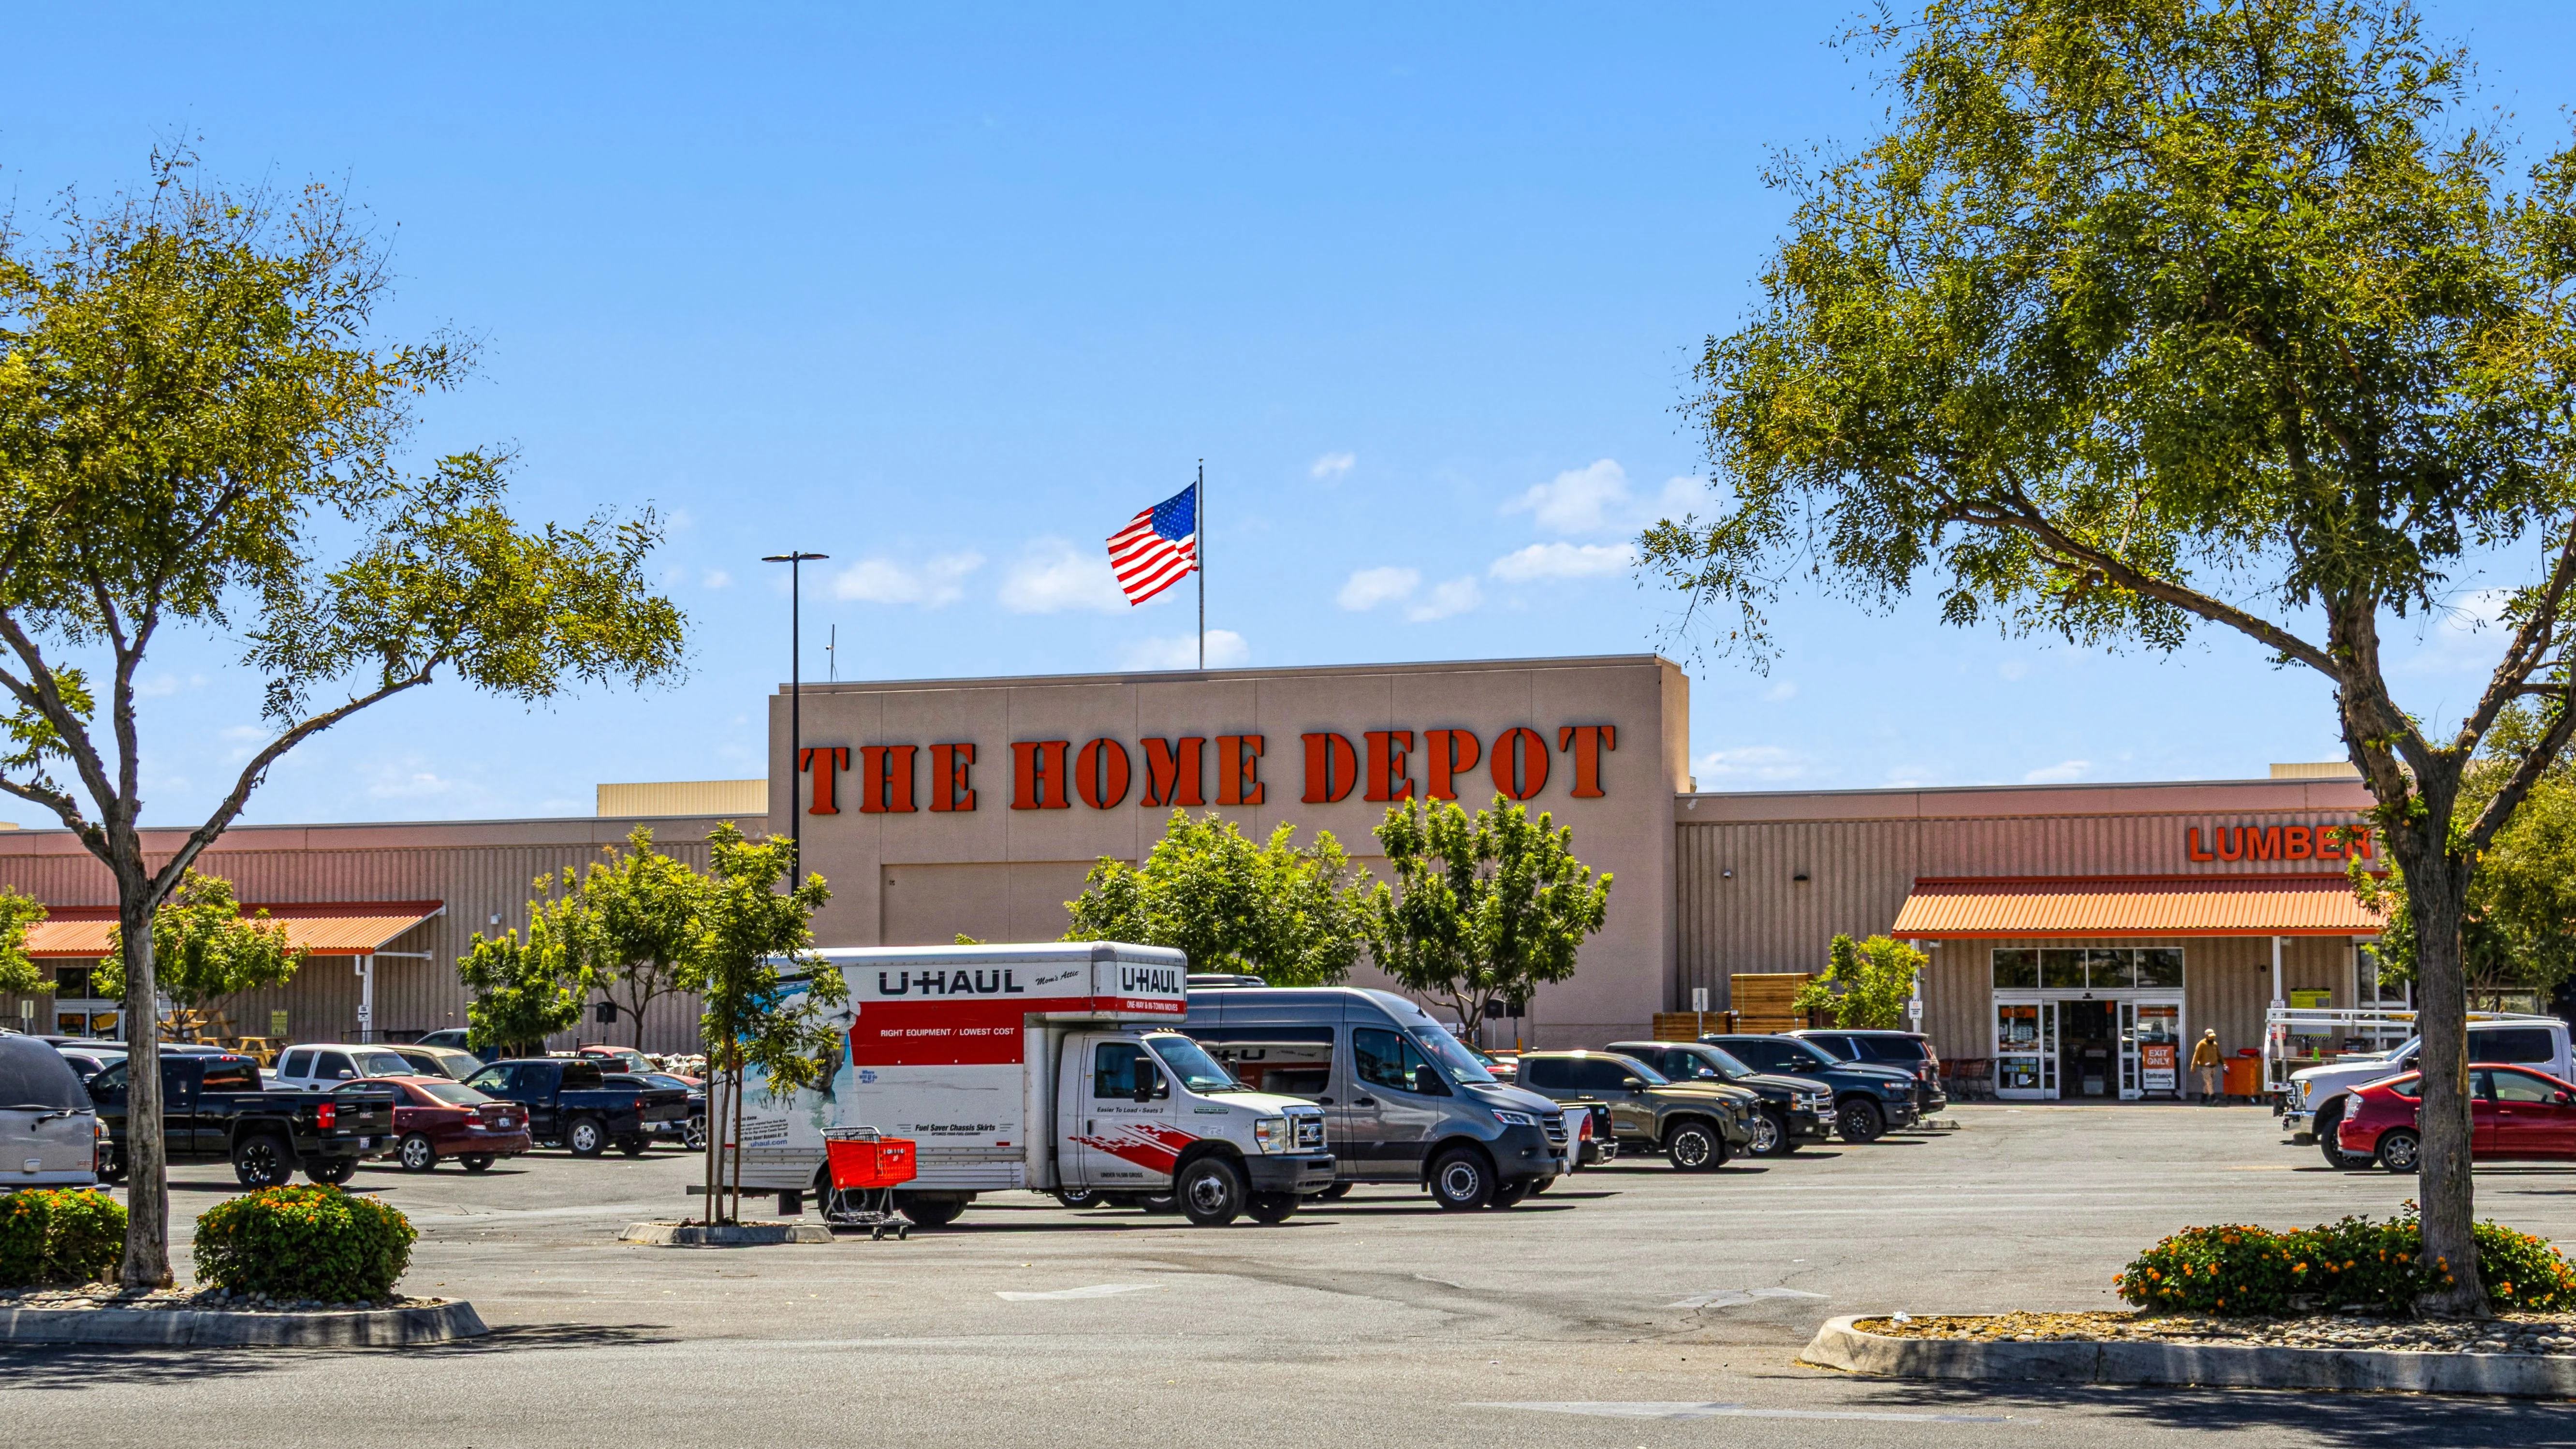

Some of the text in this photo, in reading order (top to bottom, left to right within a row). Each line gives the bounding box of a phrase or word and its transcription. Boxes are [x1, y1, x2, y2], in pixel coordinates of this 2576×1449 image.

[800, 725, 1616, 815] THE HOME DEPOT
[2189, 824, 2372, 862] LUMBER
[878, 969, 1025, 995] U-HAUL
[1035, 971, 1079, 986] Mom's Attic
[1122, 967, 1179, 994] U-HAUL
[1127, 1000, 1144, 1009] ONE-WAY
[1148, 1002, 1164, 1010] IN-TOWN
[1165, 1003, 1178, 1011] MOVES
[880, 1029, 904, 1037] RIGHT
[906, 1028, 951, 1037] EQUIPMENT
[959, 1028, 991, 1036] LOWEST
[950, 1123, 975, 1131] Chassis
[976, 1123, 996, 1131] Skirts
